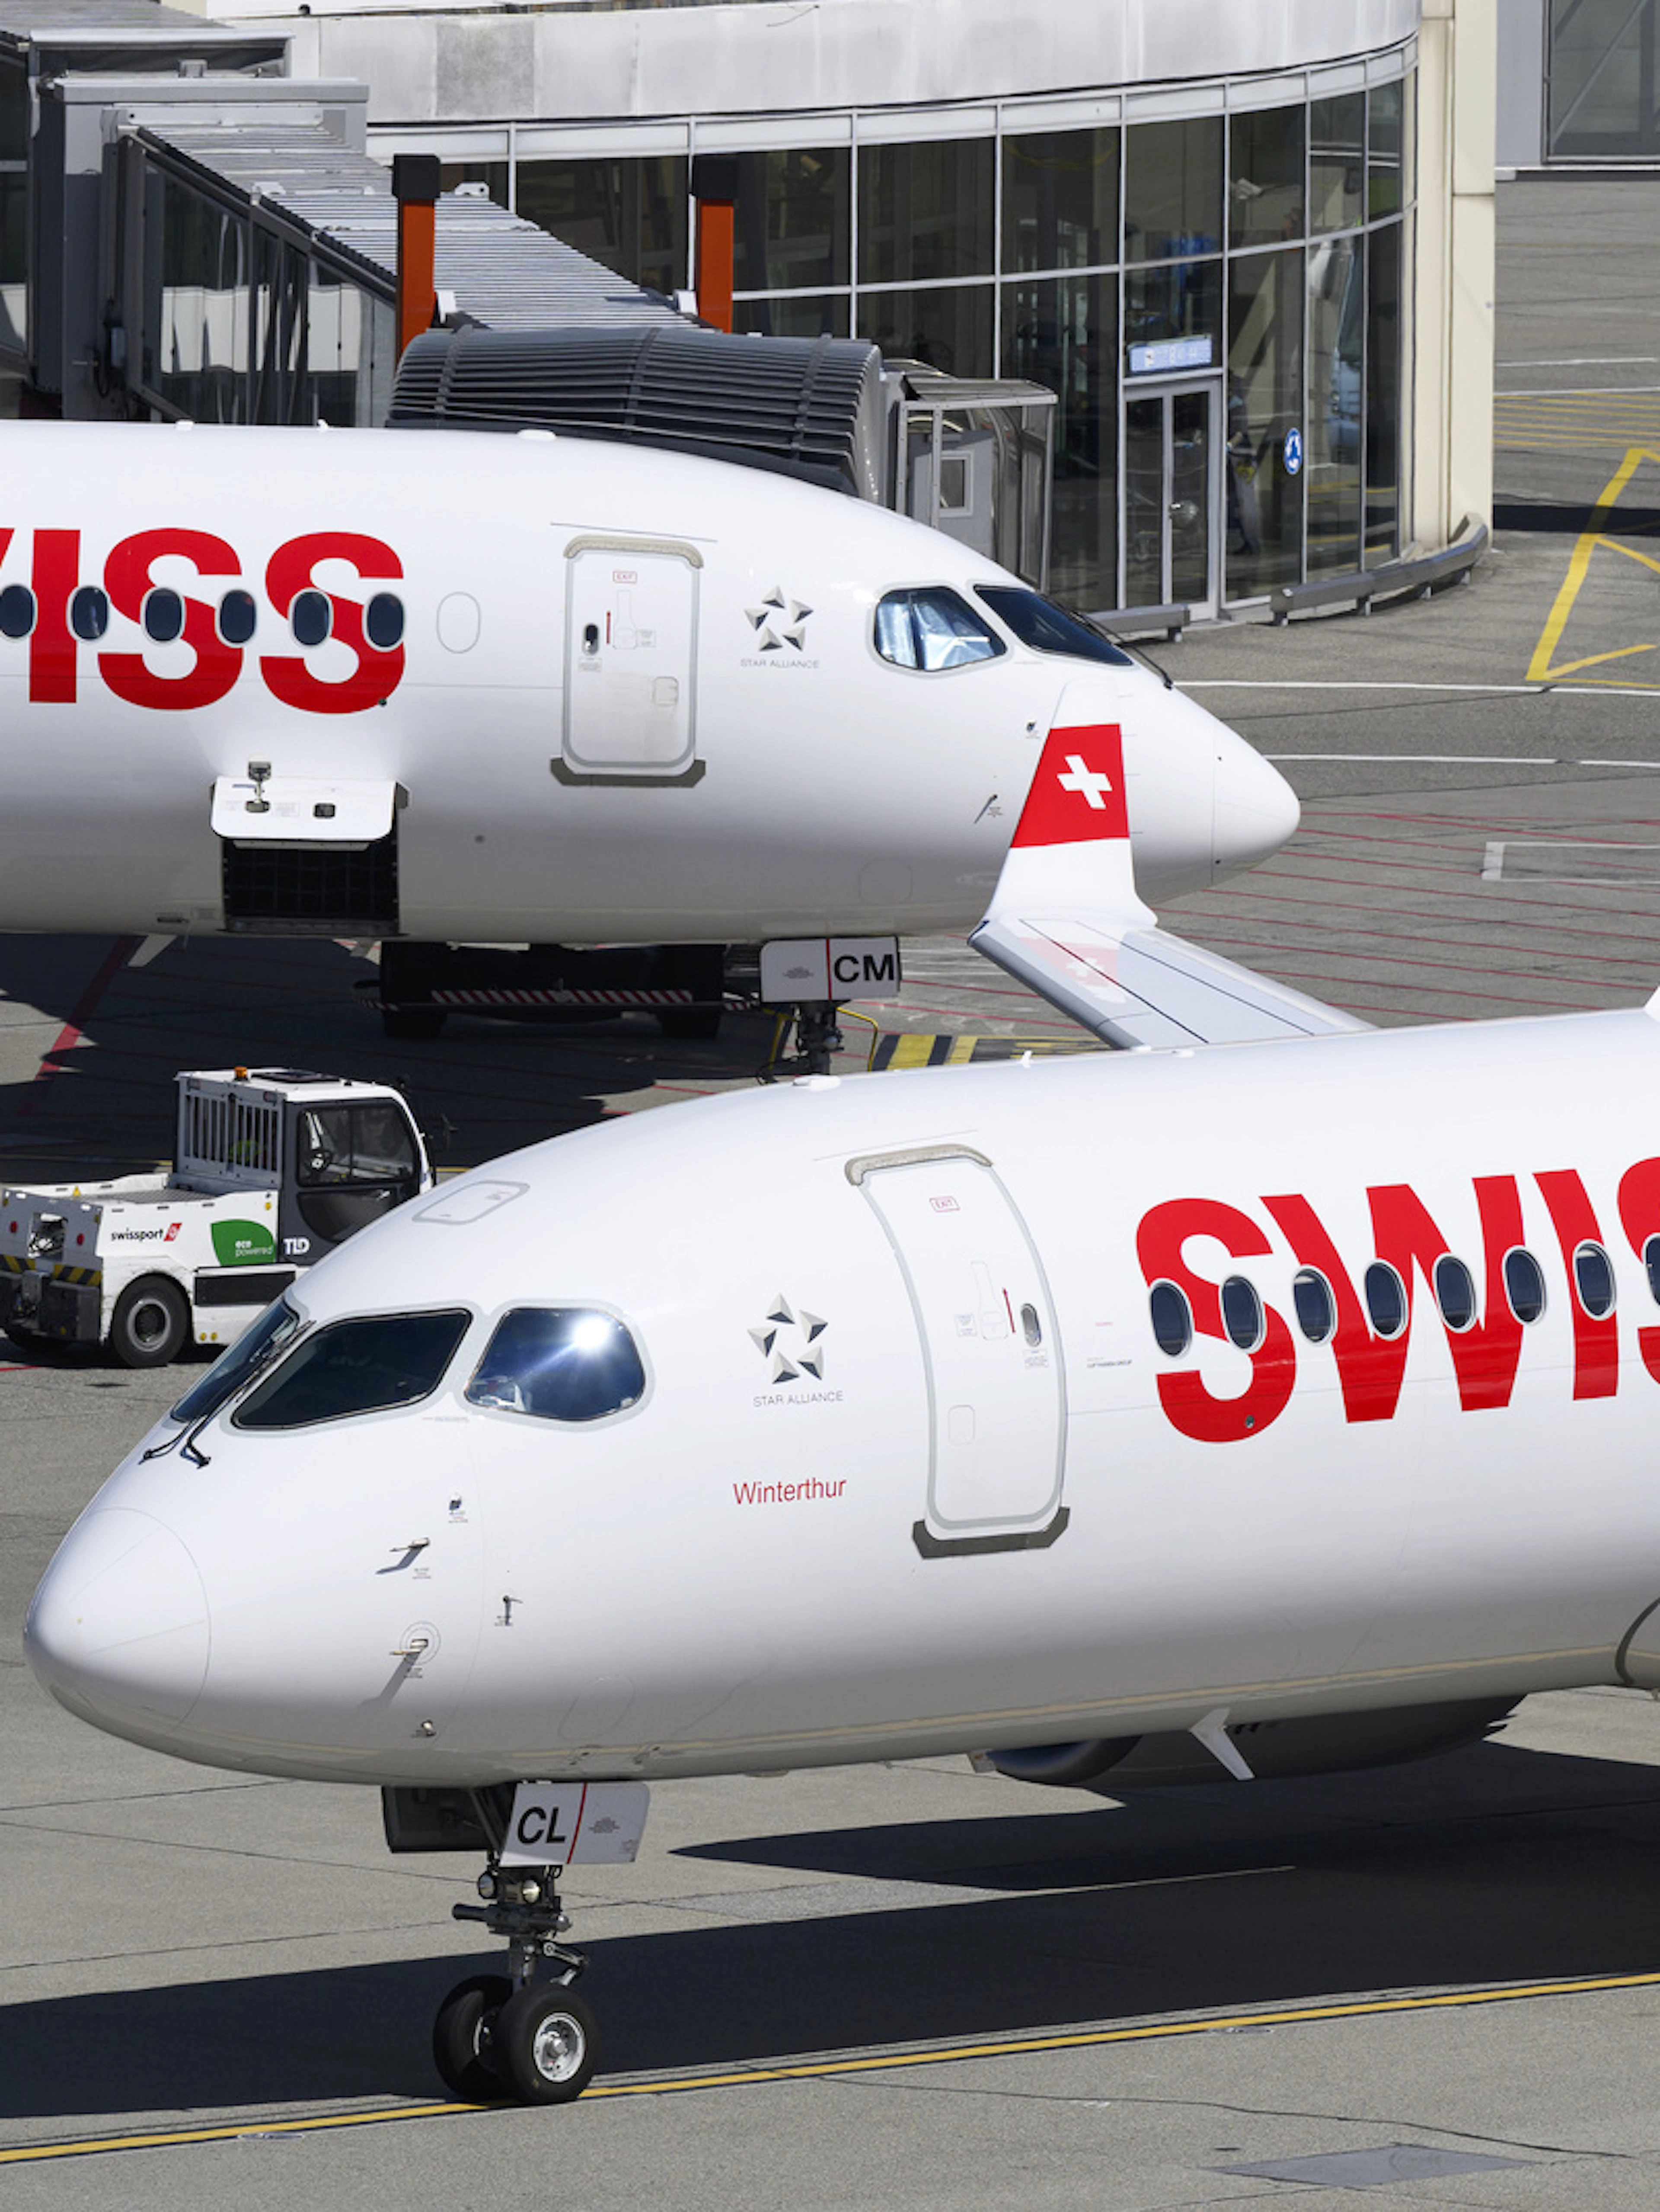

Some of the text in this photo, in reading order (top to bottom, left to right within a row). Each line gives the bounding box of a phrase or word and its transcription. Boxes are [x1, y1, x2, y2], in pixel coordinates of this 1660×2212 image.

[0, 528, 405, 713] ISS
[740, 658, 820, 669] STAR ALLIANCE
[834, 954, 894, 983] CM
[111, 1227, 163, 1243] swissport
[235, 1240, 252, 1249] eco
[235, 1245, 274, 1258] powered
[283, 1237, 310, 1255] TLD
[753, 1390, 844, 1407] STAR ALLIANCE
[733, 1477, 847, 1505] Winterthur
[517, 1806, 566, 1845] CL
